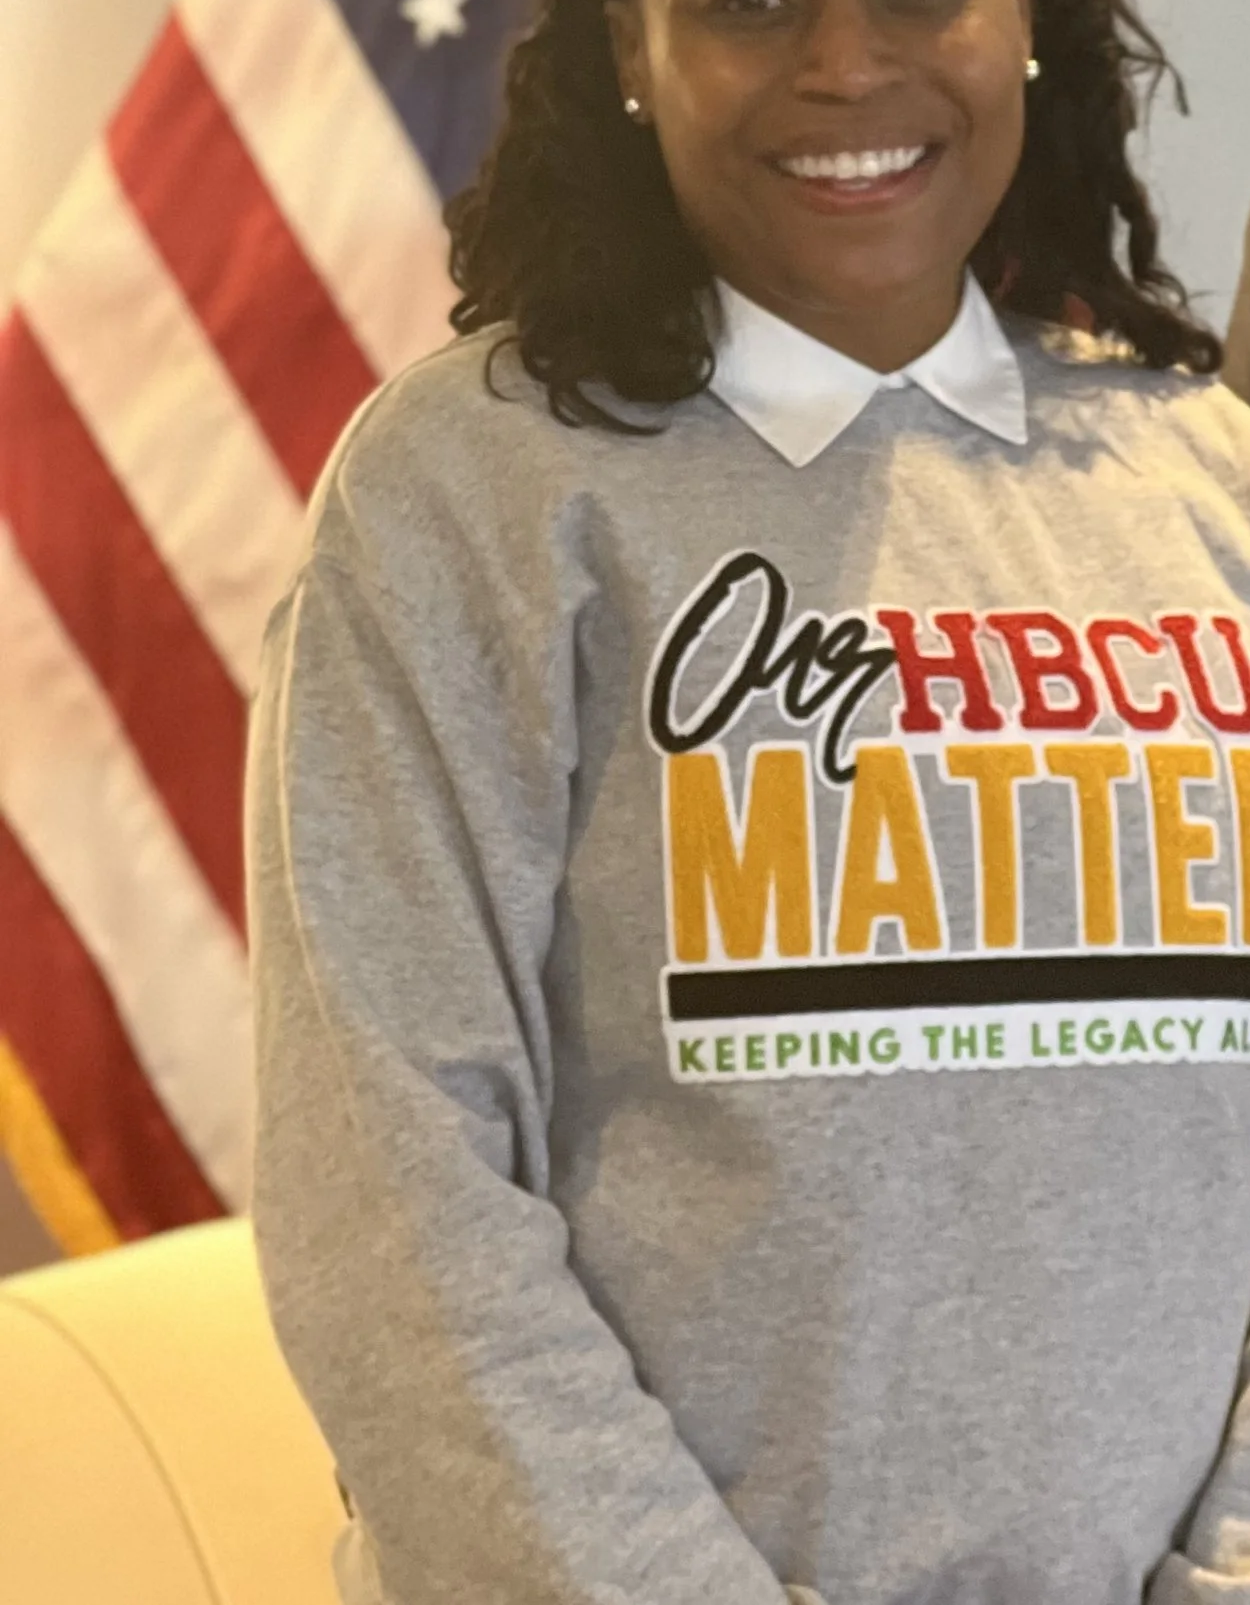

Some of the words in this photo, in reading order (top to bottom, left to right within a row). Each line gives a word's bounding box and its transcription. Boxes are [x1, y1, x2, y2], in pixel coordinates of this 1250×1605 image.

[677, 1026, 902, 1074] KEEPING
[921, 1021, 1005, 1061] THE
[1029, 1016, 1204, 1058] LEGACY
